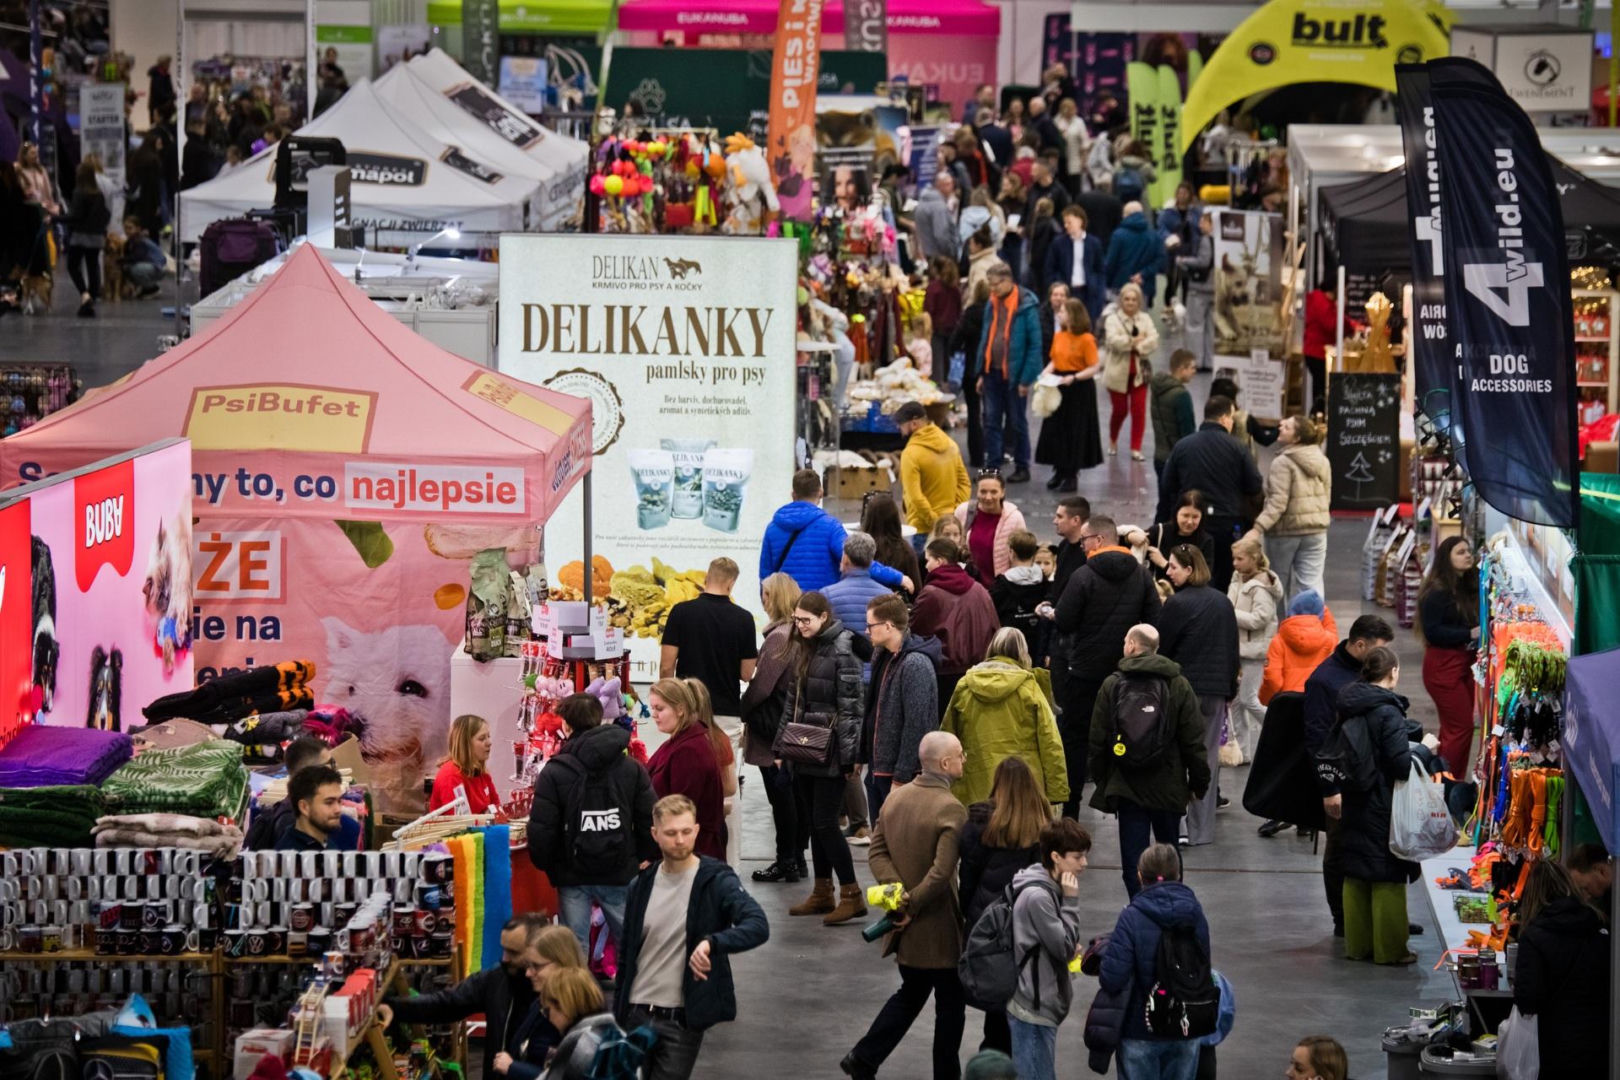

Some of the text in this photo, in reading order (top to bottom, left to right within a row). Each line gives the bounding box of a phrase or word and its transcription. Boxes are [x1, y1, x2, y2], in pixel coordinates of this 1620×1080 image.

[677, 12, 748, 25] EUKANUBA
[1292, 12, 1386, 43] bult
[782, 37, 803, 109] PIES
[592, 255, 659, 280] DELIKAN
[592, 281, 627, 289] KRMIVO
[649, 282, 664, 290] PSY
[675, 281, 703, 291] KOČKY
[521, 303, 774, 357] DELIKANKY
[646, 360, 766, 386] pamlsky pro psy
[1489, 354, 1529, 375] DOG
[1471, 379, 1552, 393] ACCESSORIES
[201, 391, 362, 417] PsiBufet
[235, 467, 284, 501] to,
[293, 473, 336, 498] co
[352, 468, 517, 510] najlepsie
[86, 494, 124, 548] BUBA
[236, 615, 281, 641] na
[579, 807, 621, 833] ANS
